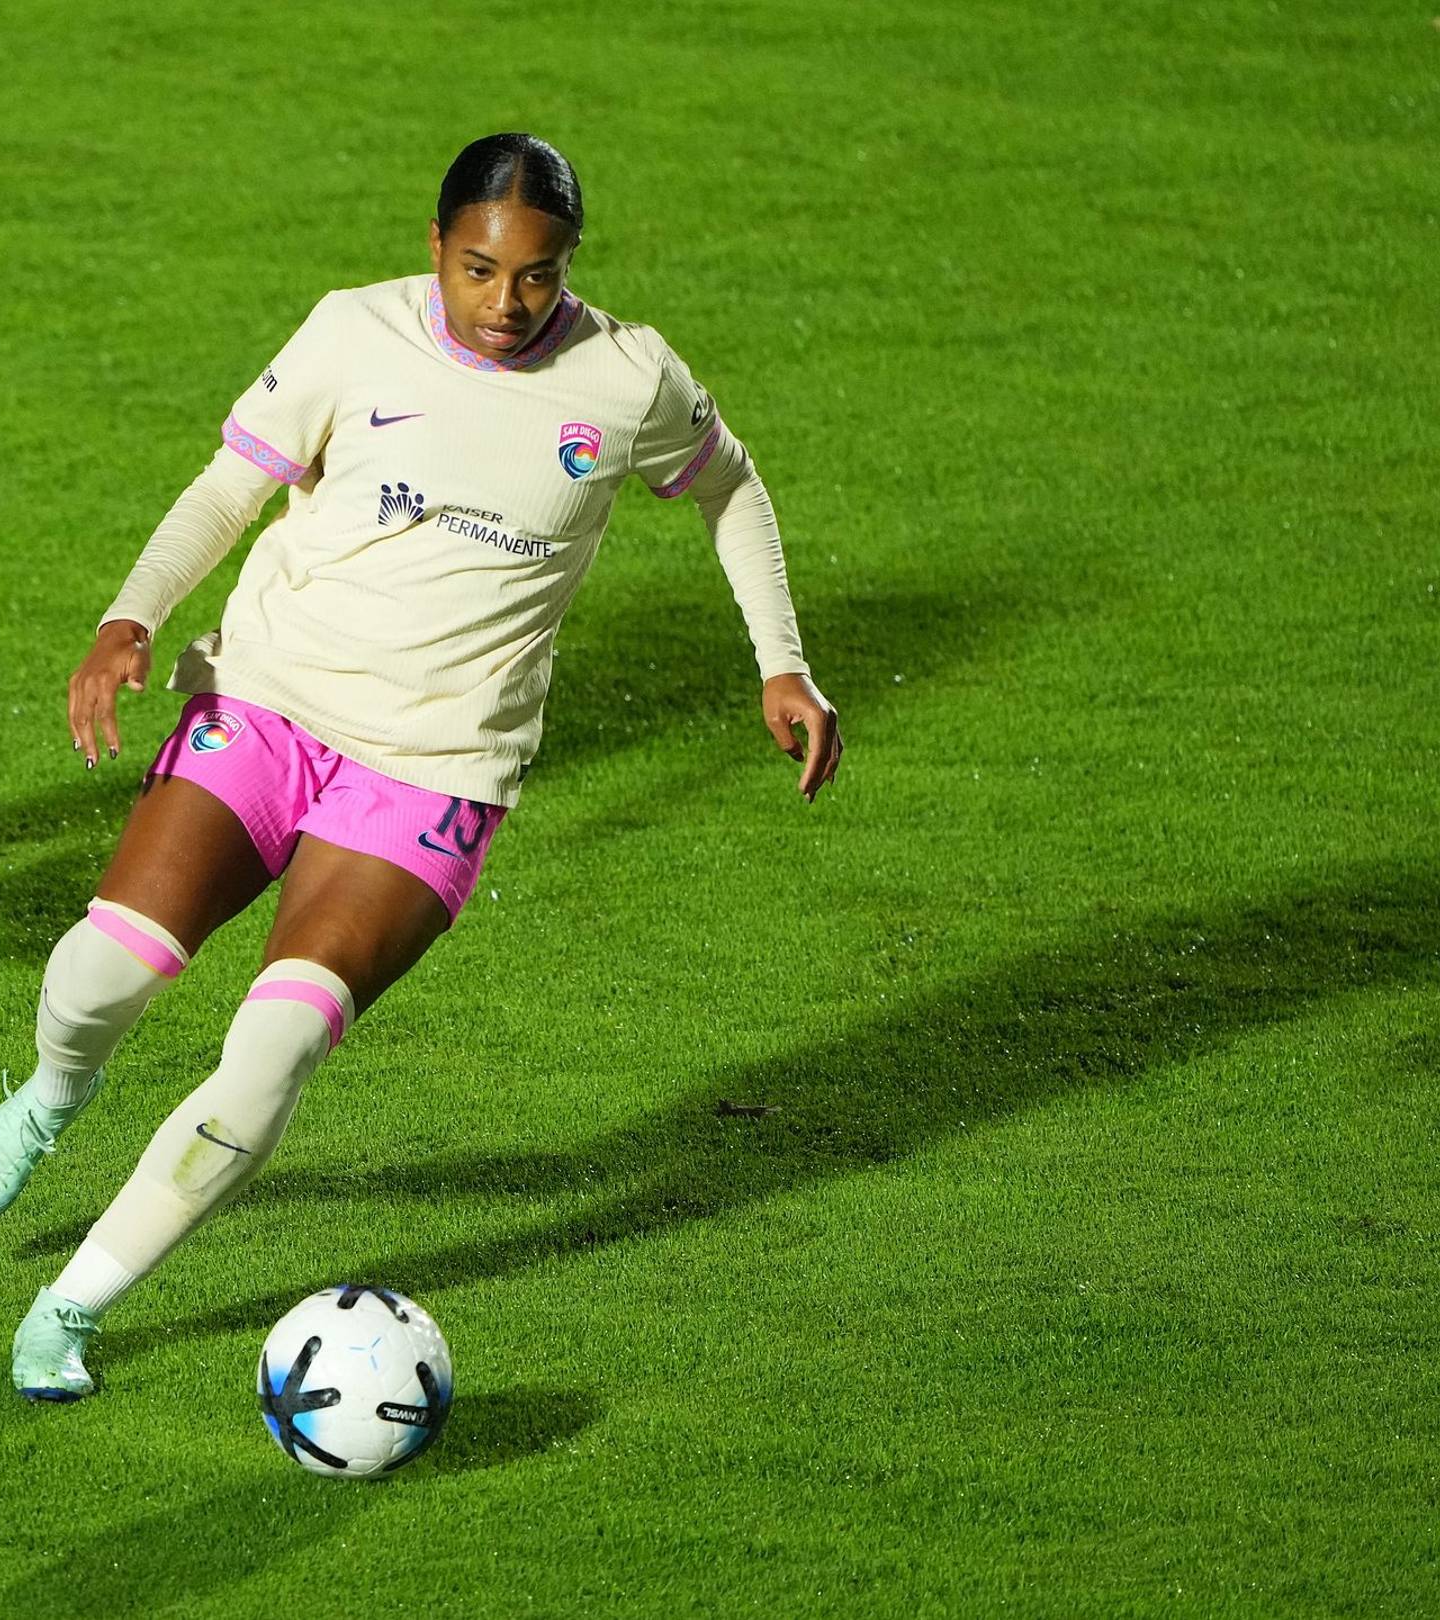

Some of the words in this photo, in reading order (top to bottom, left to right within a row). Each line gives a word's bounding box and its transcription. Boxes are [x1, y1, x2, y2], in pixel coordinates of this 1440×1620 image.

[562, 424, 579, 438] SAN
[579, 426, 600, 443] DIEGO
[442, 504, 503, 525] KAISER
[436, 513, 553, 558] PERMANENTE
[220, 713, 241, 732] DIEGO
